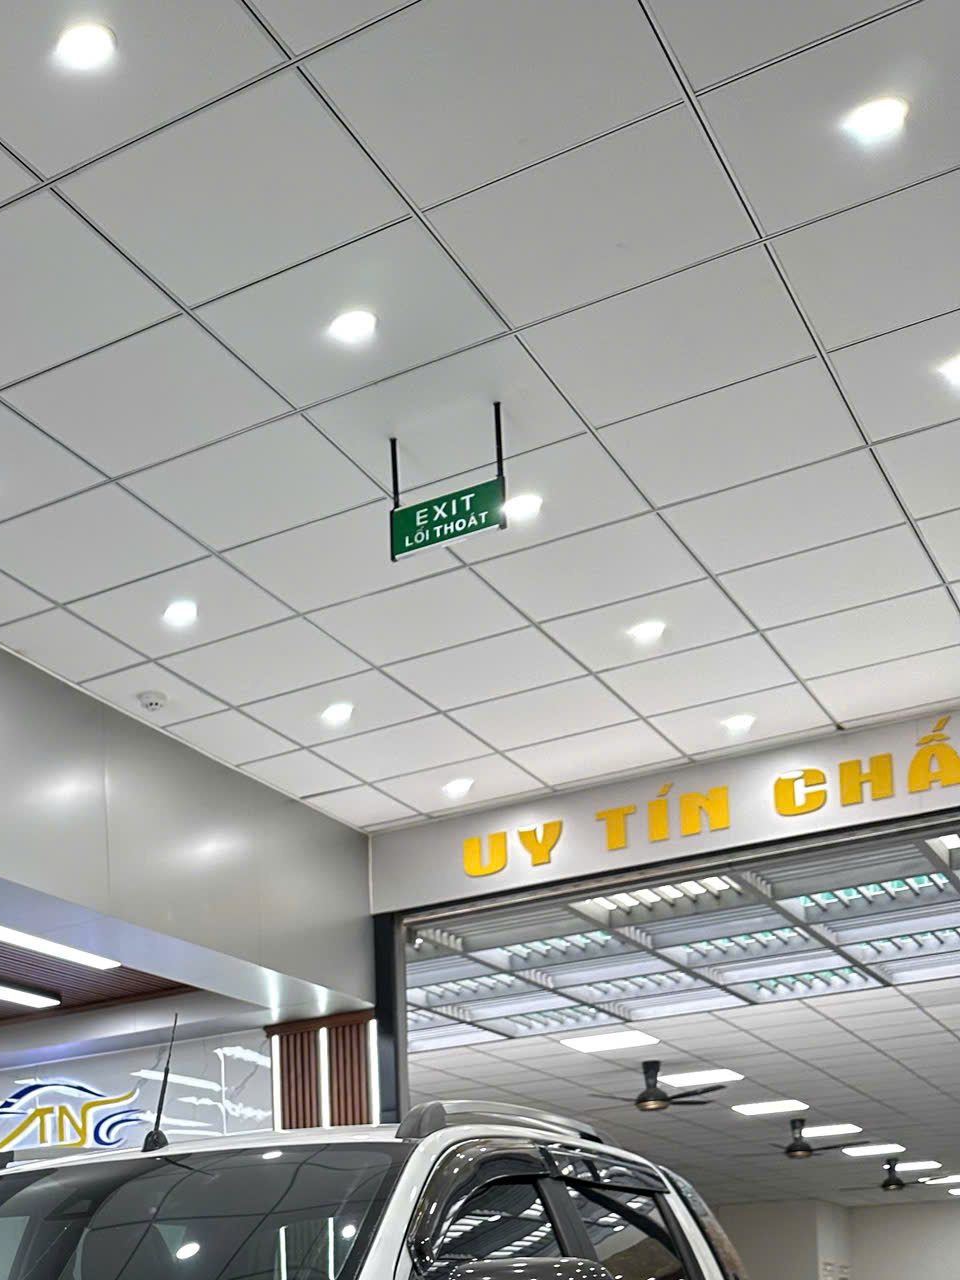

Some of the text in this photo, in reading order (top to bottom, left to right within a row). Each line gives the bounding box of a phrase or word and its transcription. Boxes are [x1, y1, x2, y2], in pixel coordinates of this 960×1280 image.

[415, 493, 475, 526] EXIT
[434, 511, 489, 538] THOÁT
[462, 715, 960, 878] UY TÍN CHẤ
